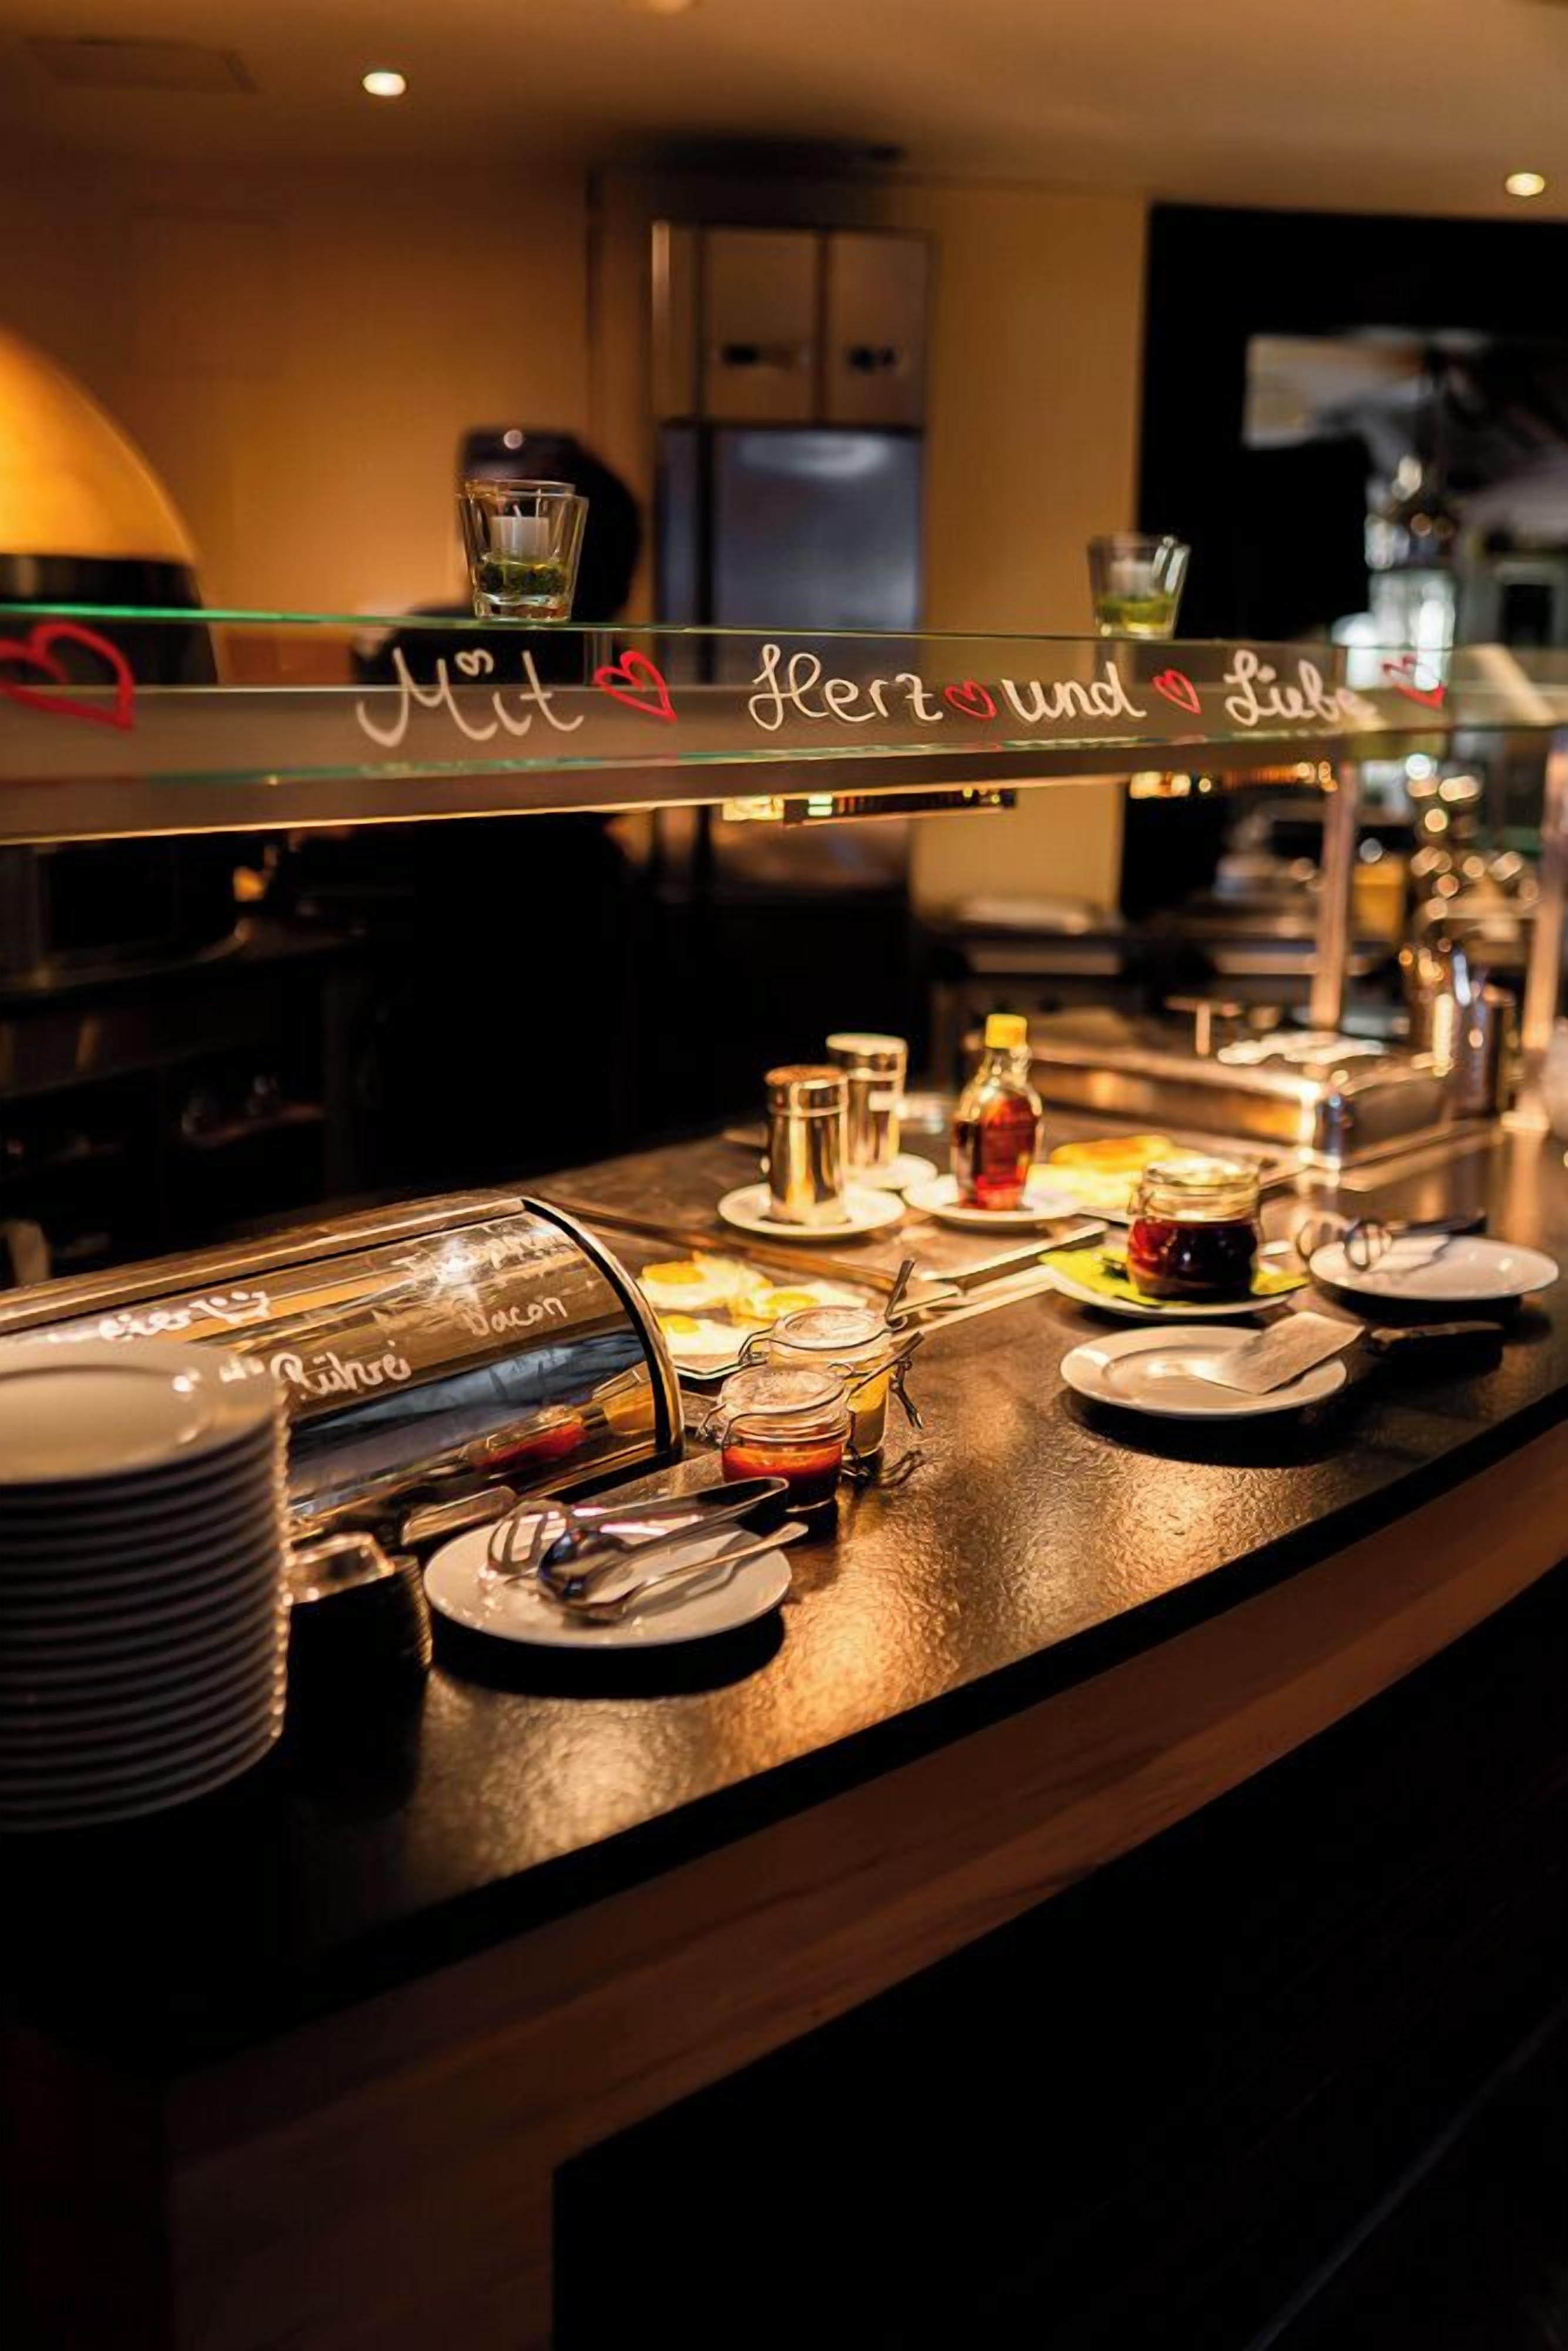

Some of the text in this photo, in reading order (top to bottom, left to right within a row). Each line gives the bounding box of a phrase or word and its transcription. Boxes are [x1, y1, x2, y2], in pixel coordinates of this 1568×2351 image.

[356, 646, 584, 747] Mit
[748, 644, 943, 731] Herz
[1001, 661, 1147, 723] und
